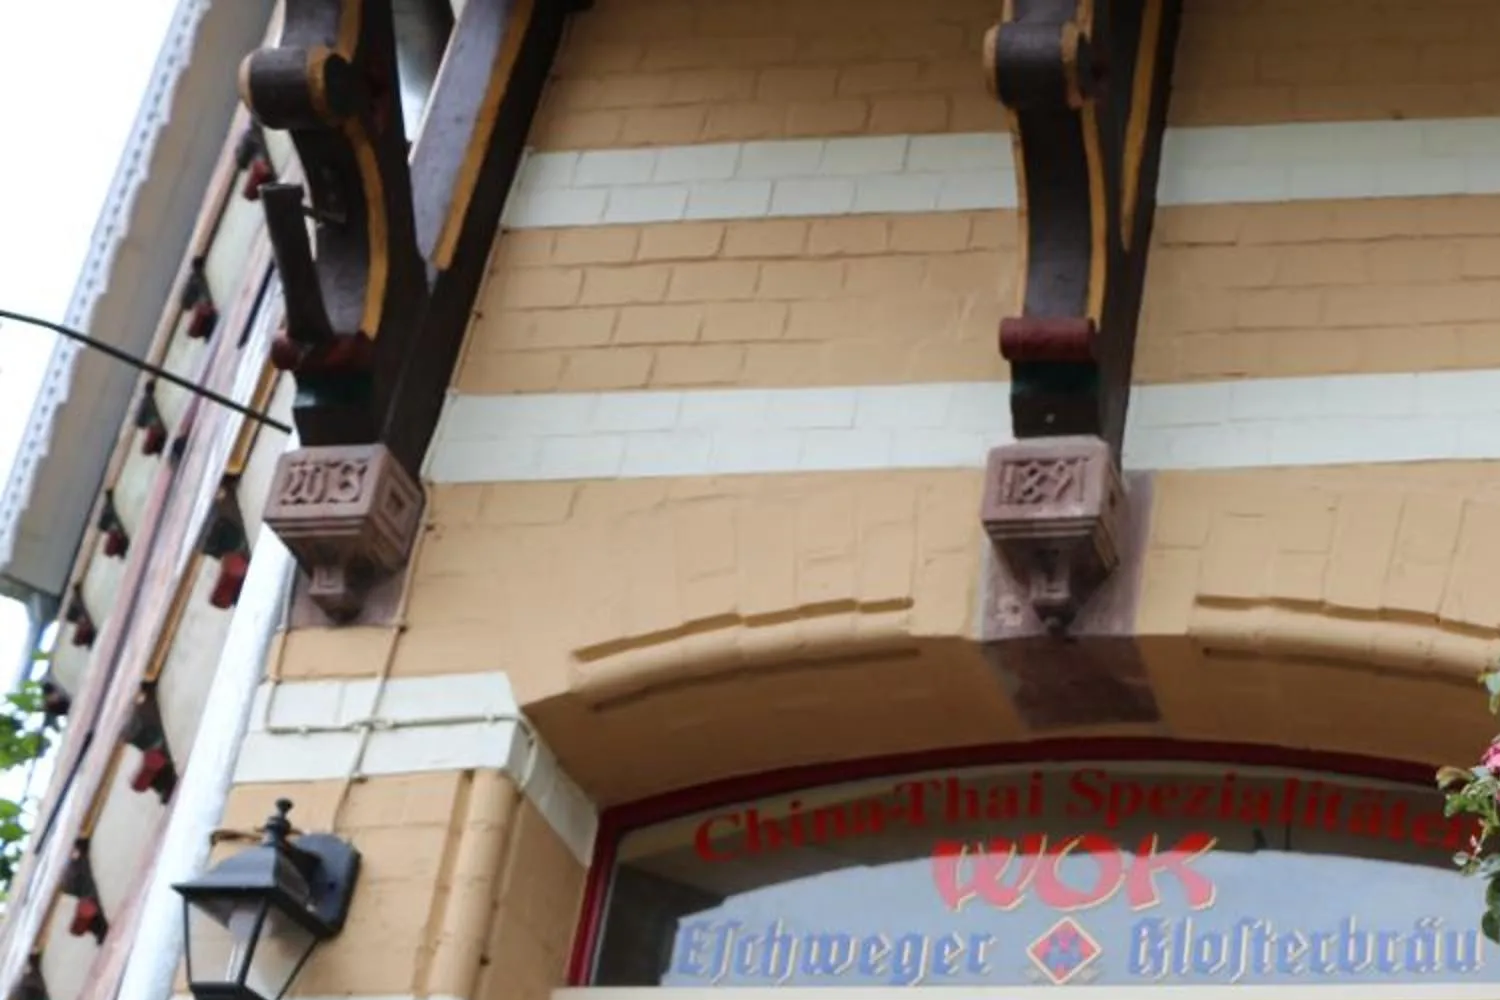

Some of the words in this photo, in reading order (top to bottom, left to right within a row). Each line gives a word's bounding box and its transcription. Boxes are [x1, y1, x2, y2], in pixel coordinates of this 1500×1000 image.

[694, 770, 1046, 863] China-Thai
[931, 832, 1218, 913] WOK
[1128, 915, 1487, 984] Klosterbräu
